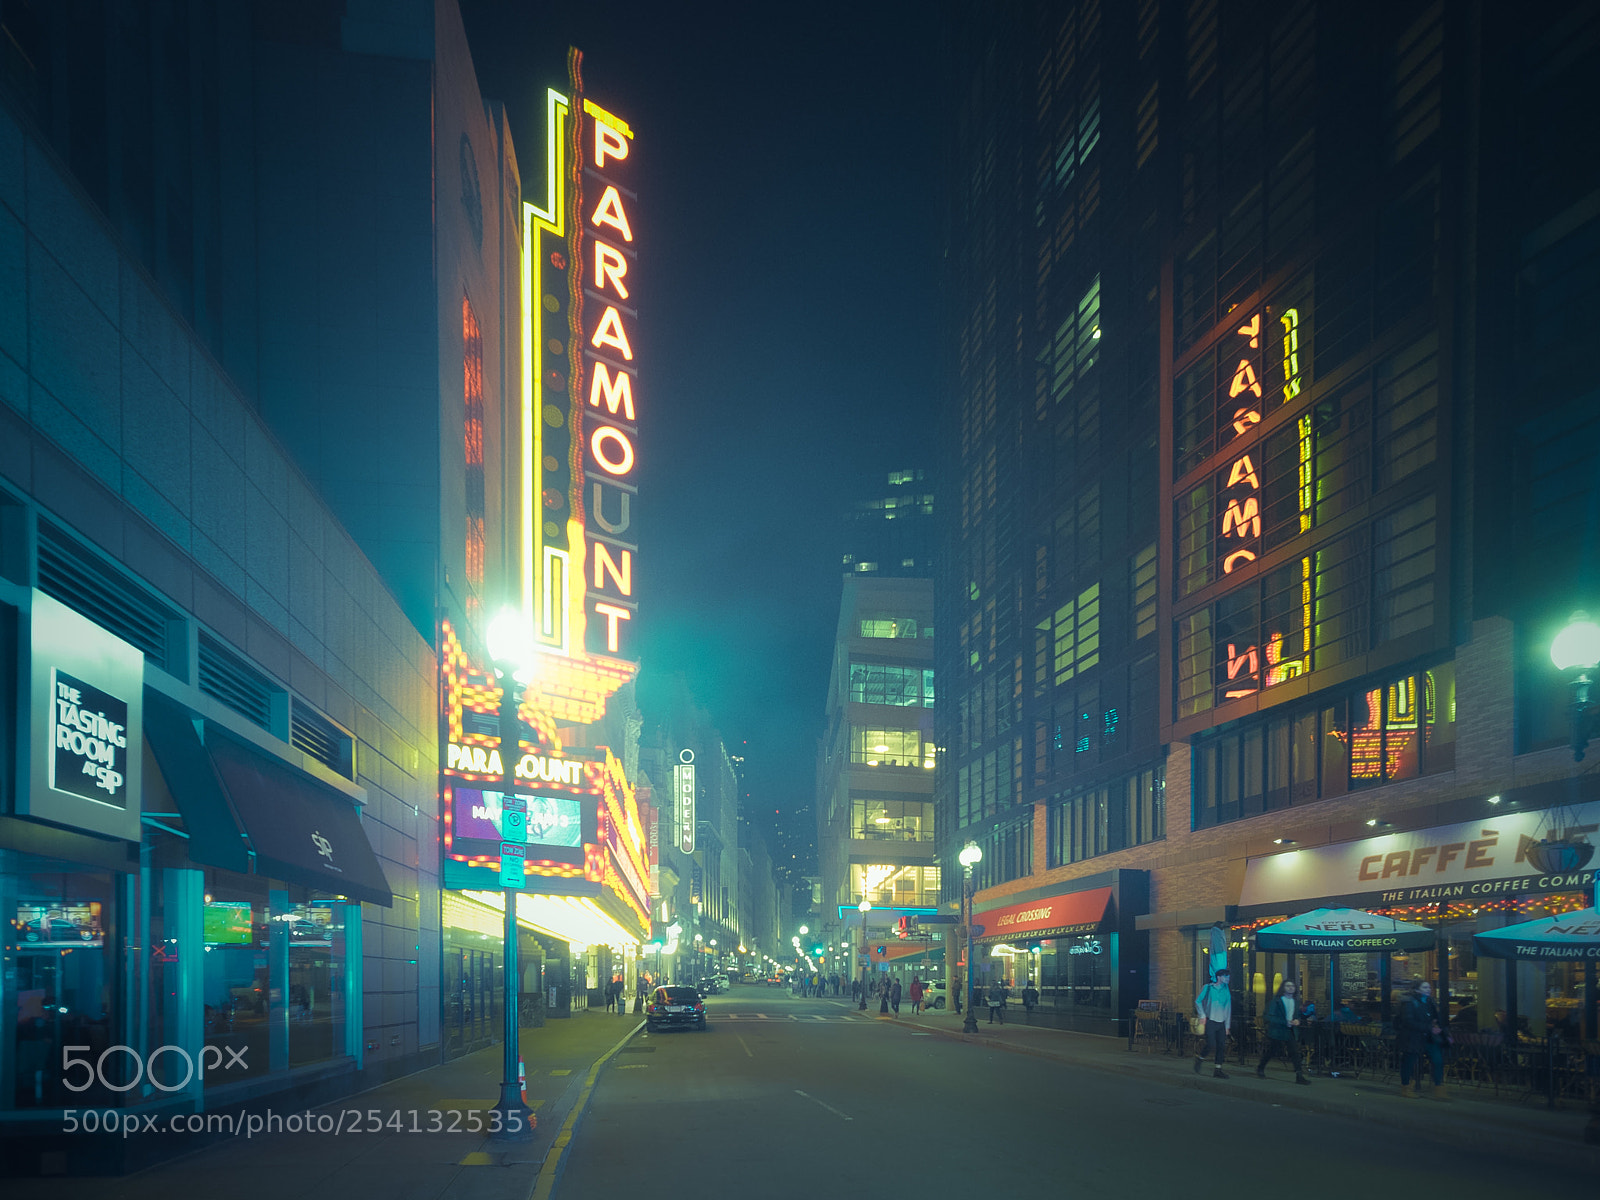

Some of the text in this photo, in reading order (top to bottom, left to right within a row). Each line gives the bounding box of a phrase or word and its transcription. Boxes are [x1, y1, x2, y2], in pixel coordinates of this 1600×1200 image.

[590, 118, 635, 652] PARAMOUNT
[57, 681, 82, 705] THE
[57, 723, 115, 769] ROOM
[82, 760, 99, 776] AT
[447, 743, 584, 785] PARAOUNT
[682, 772, 692, 843] MODERN
[1381, 891, 1404, 902] THE
[1409, 885, 1464, 900] ITALIAN
[1471, 879, 1530, 894] COFFEE
[997, 907, 1052, 926] LEGAL CROSSING
[1304, 923, 1375, 931] NERO
[1291, 938, 1309, 946] THE
[1311, 939, 1344, 947] ITALIAN
[1347, 939, 1382, 947] COFFEE
[1515, 945, 1537, 955] THE
[1540, 946, 1583, 957] ITALIAN
